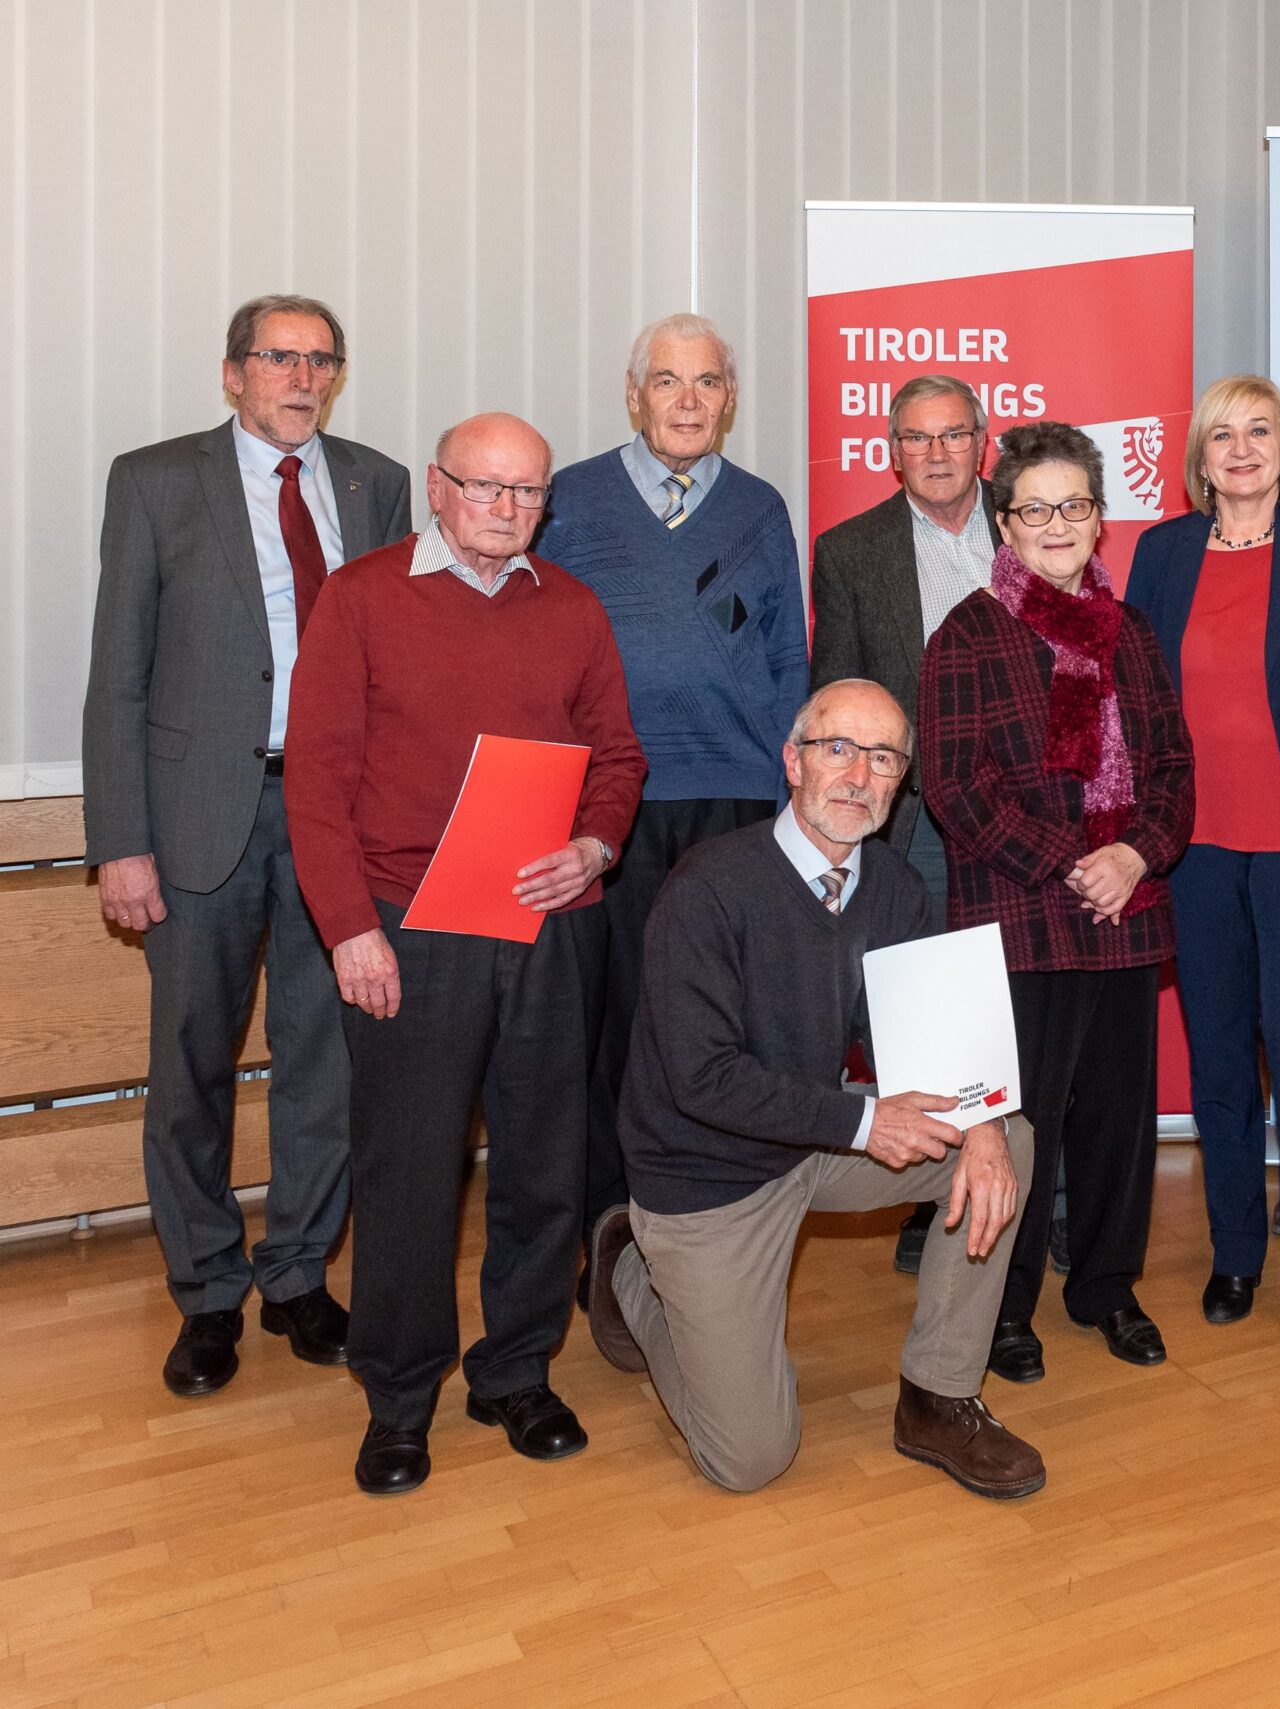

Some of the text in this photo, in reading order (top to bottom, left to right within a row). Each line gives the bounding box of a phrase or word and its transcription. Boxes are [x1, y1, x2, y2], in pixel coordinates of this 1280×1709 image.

[840, 328, 1009, 362] TIROLER
[841, 383, 1046, 417] BILNGS
[959, 1082, 984, 1094] TIROLER
[960, 1100, 981, 1111] FORUM
